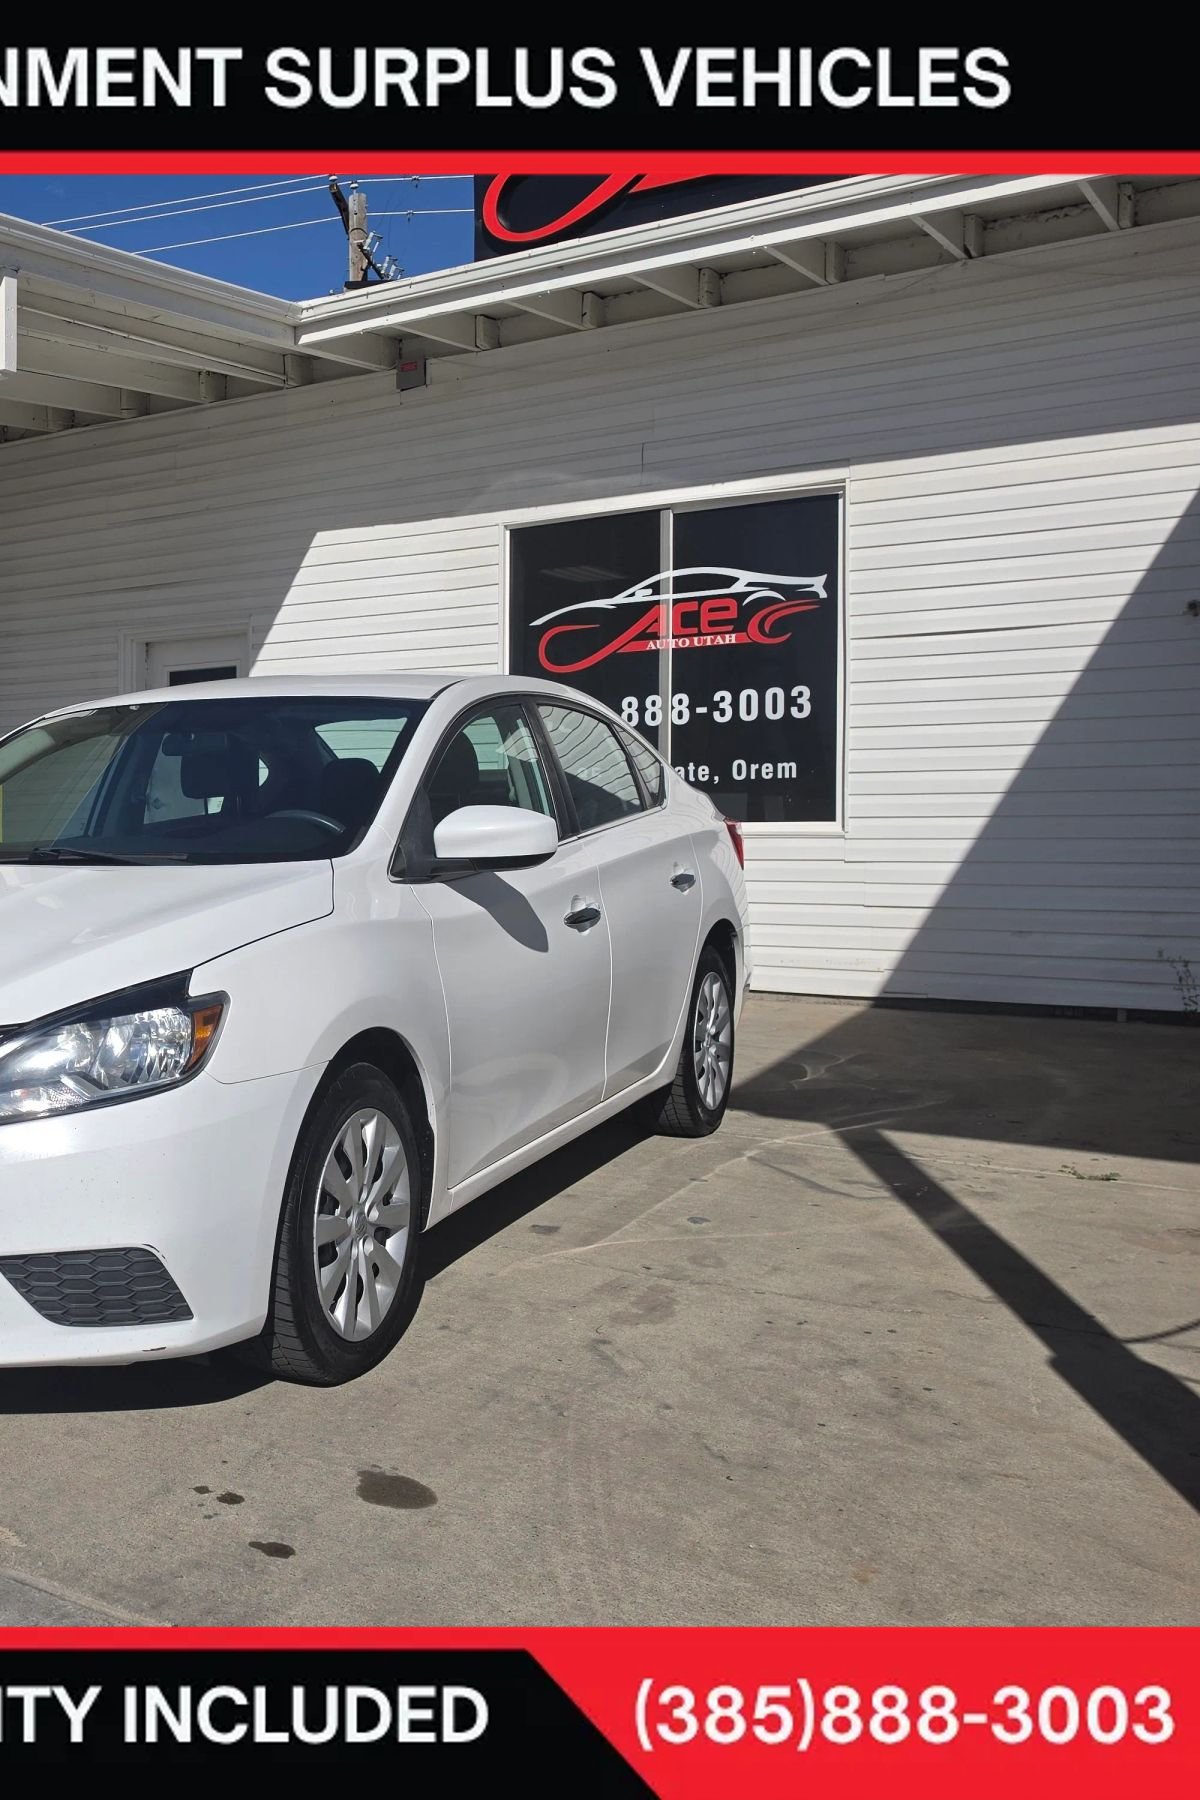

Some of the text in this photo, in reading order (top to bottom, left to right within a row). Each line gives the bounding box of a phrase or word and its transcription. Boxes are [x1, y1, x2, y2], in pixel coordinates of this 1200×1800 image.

[646, 633, 737, 650] AUTO UTAH
[620, 684, 813, 728] 888-3003
[674, 759, 798, 784] ate, Orem
